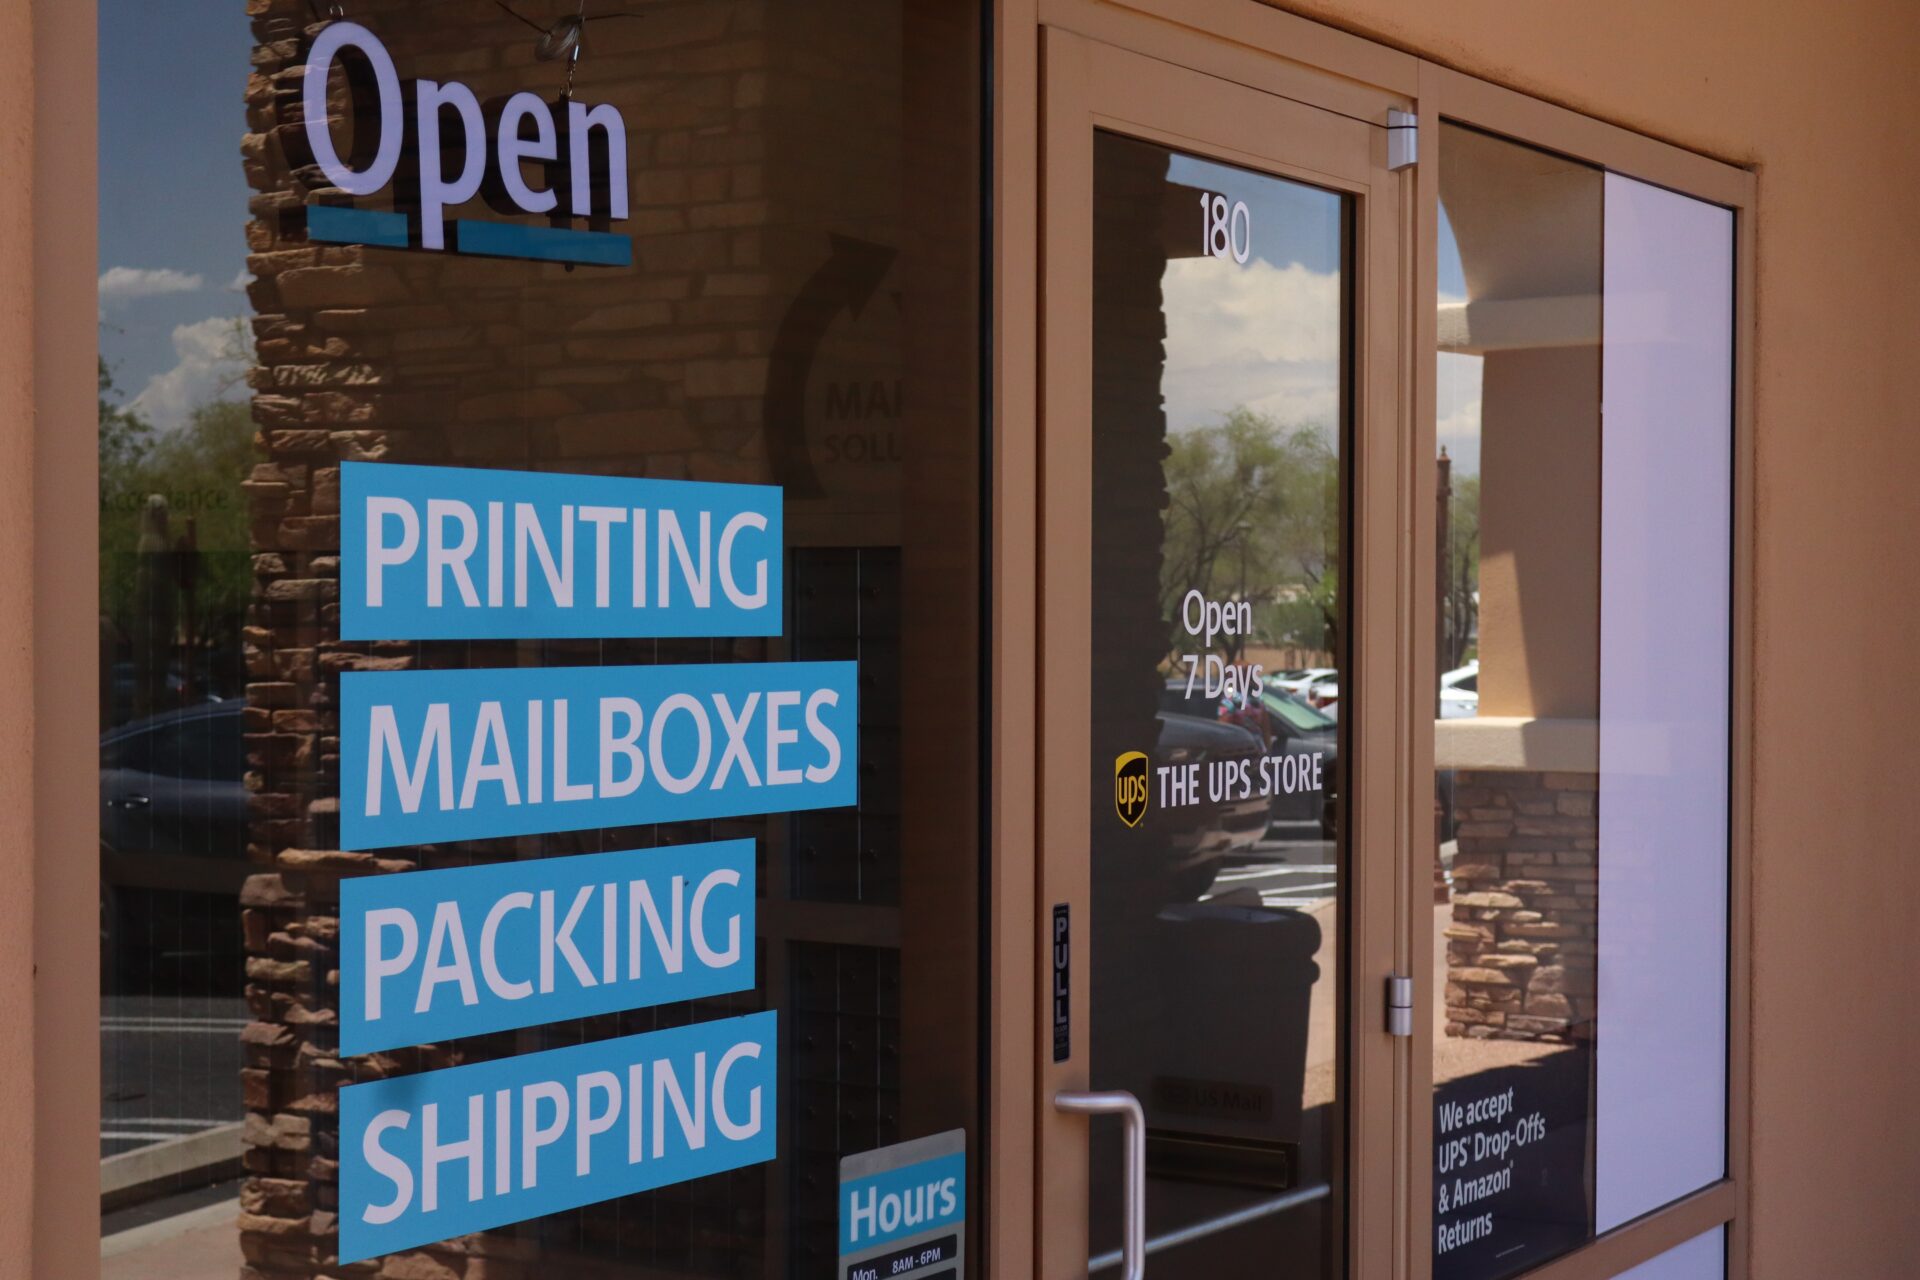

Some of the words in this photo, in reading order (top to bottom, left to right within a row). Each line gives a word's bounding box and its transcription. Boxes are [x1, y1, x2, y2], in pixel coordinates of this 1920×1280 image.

[303, 22, 629, 250] Open
[1200, 192, 1250, 264] 180
[366, 496, 768, 610] PRINTING
[1183, 589, 1252, 647] Open
[1182, 654, 1199, 700] 7
[1205, 654, 1264, 711] Days
[365, 687, 842, 817] MAILBOXES
[1157, 764, 1200, 809] THE
[1208, 759, 1251, 803] UPS
[1259, 752, 1323, 797] STORE
[364, 868, 742, 1021] PACKING
[1055, 916, 1068, 1025] PULL
[362, 1041, 762, 1225] SHIPPING
[1439, 1101, 1463, 1134] We
[1466, 1086, 1514, 1124] accept
[1474, 1112, 1546, 1162] Drop-Offs
[850, 1177, 956, 1242] Hours
[1438, 1183, 1450, 1214] &
[892, 1256, 914, 1274] 8AM
[920, 1247, 941, 1265] 6PM
[1438, 1212, 1493, 1255] Returns
